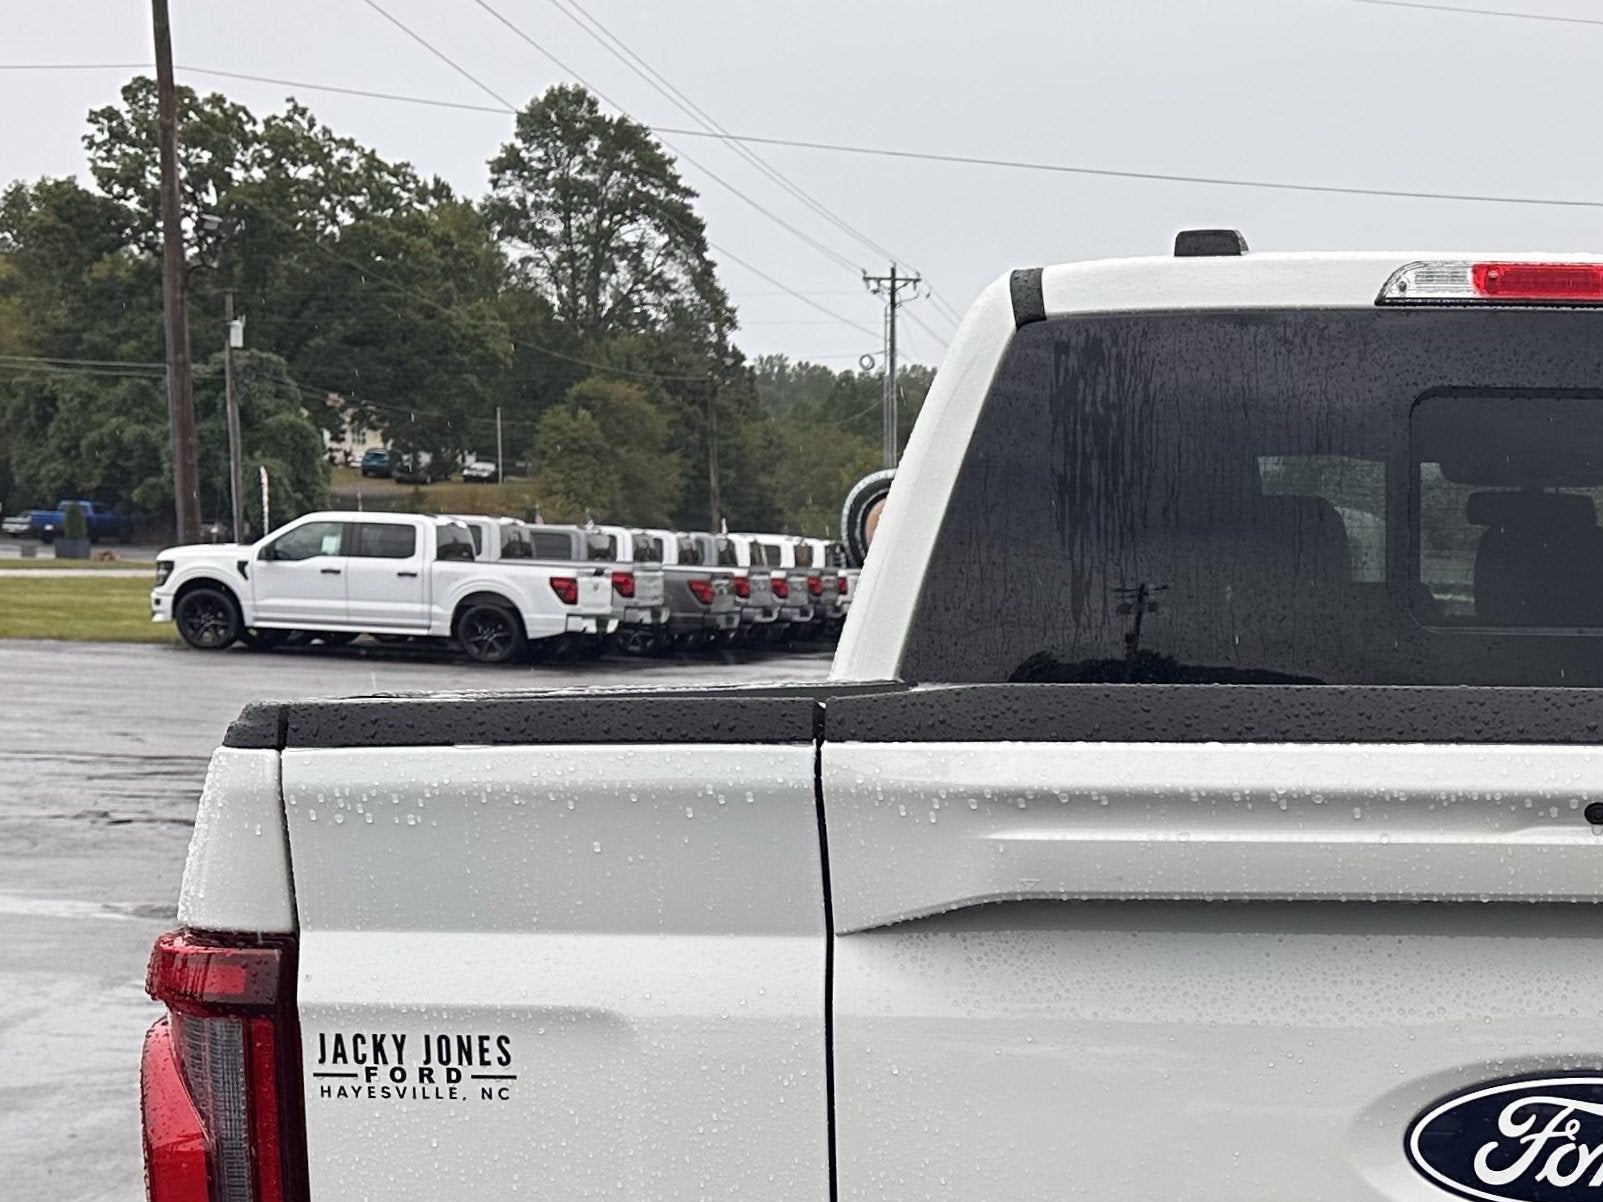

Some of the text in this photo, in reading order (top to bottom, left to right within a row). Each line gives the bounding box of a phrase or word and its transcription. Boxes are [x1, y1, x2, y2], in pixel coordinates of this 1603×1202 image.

[318, 1033, 512, 1067] JACKY JONES
[364, 1066, 462, 1084] FORD
[320, 1085, 511, 1101] HAYESVILLE, NC
